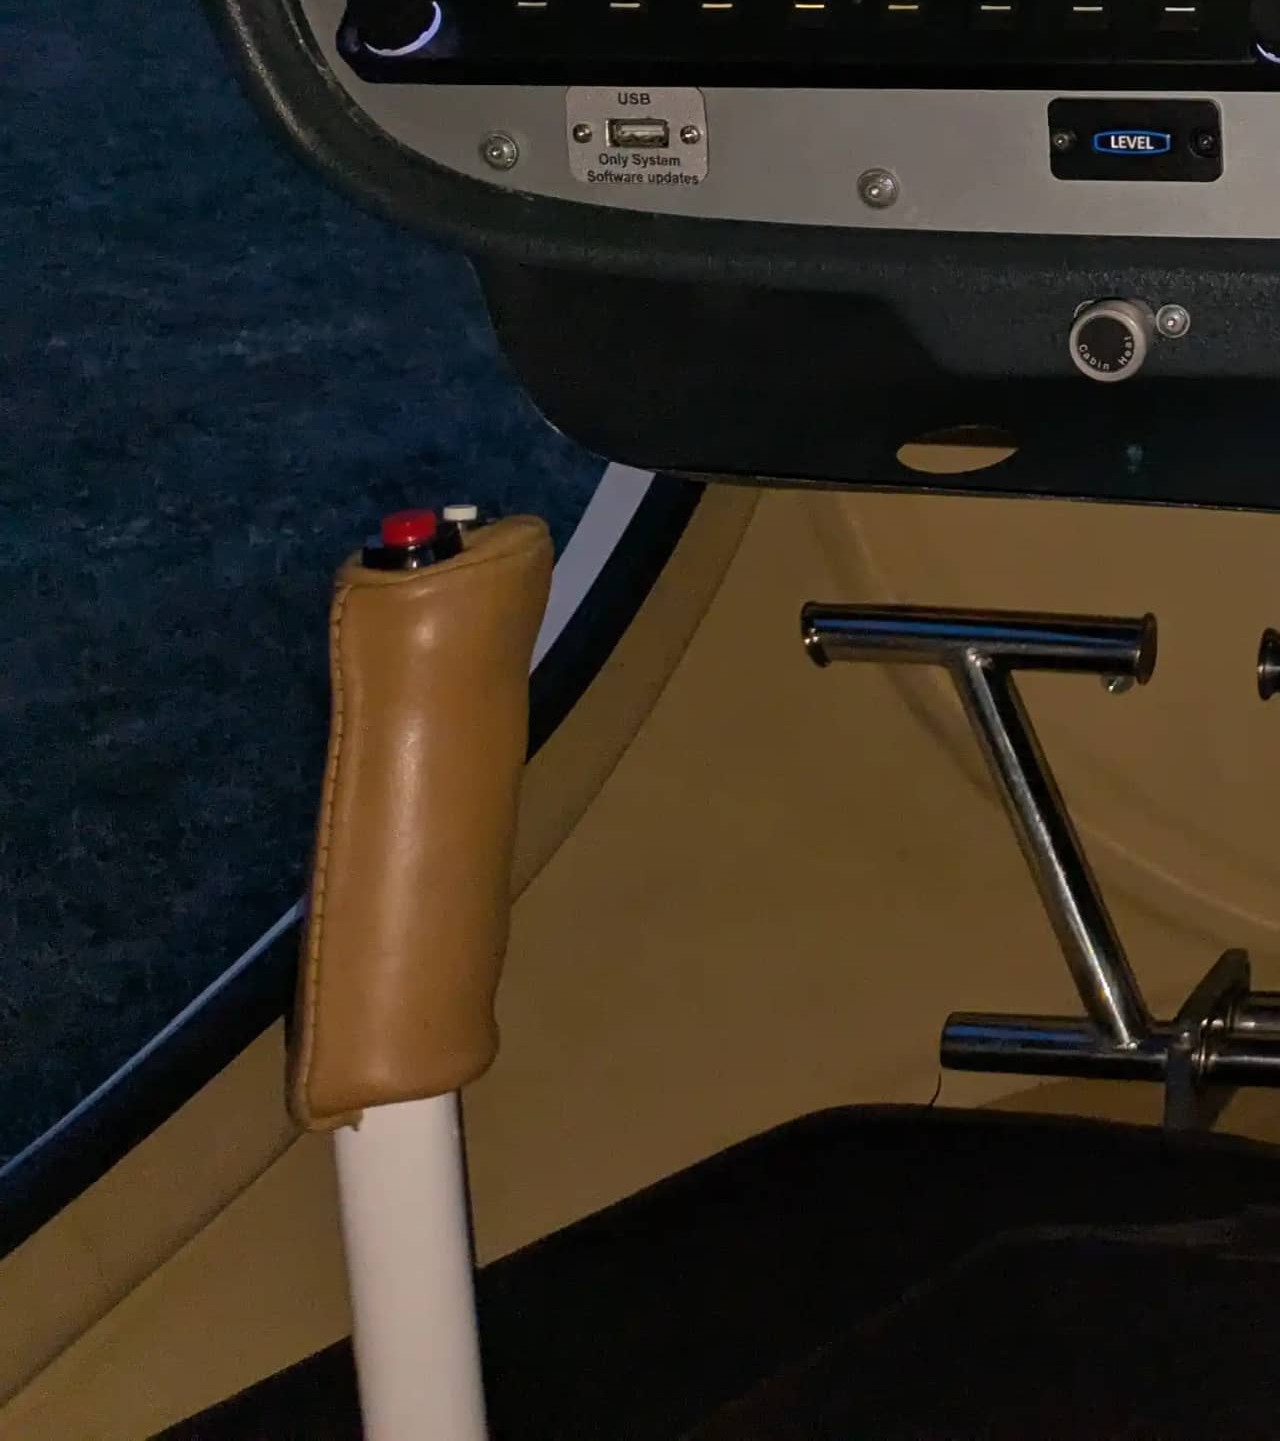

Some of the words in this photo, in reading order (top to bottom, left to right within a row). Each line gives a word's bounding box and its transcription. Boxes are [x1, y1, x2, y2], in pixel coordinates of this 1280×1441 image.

[618, 93, 651, 105] USB
[1108, 134, 1154, 151] LEVEL
[599, 153, 628, 167] Only
[632, 153, 680, 168] System
[587, 170, 643, 183] Software
[648, 171, 699, 186] updates
